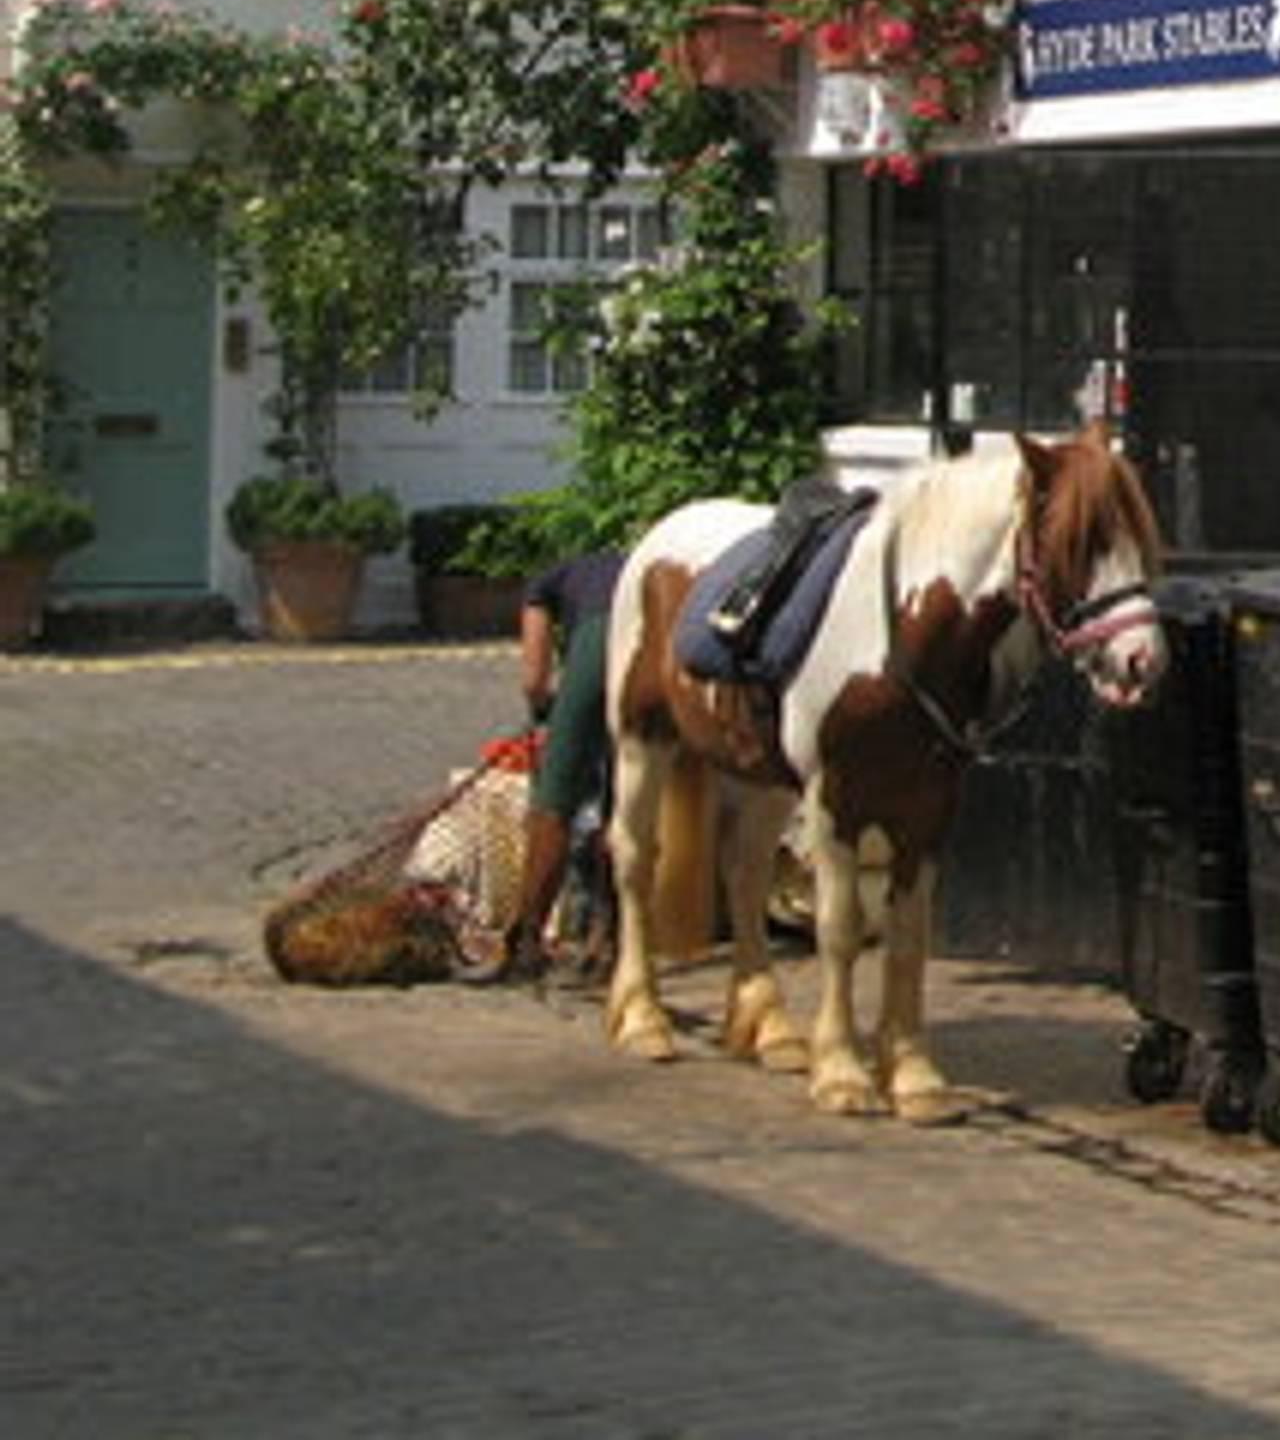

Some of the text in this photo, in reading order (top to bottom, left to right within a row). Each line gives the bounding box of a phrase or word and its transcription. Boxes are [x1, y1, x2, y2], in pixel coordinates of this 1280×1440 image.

[1036, 6, 1266, 71] HYDE PARK STABLES
